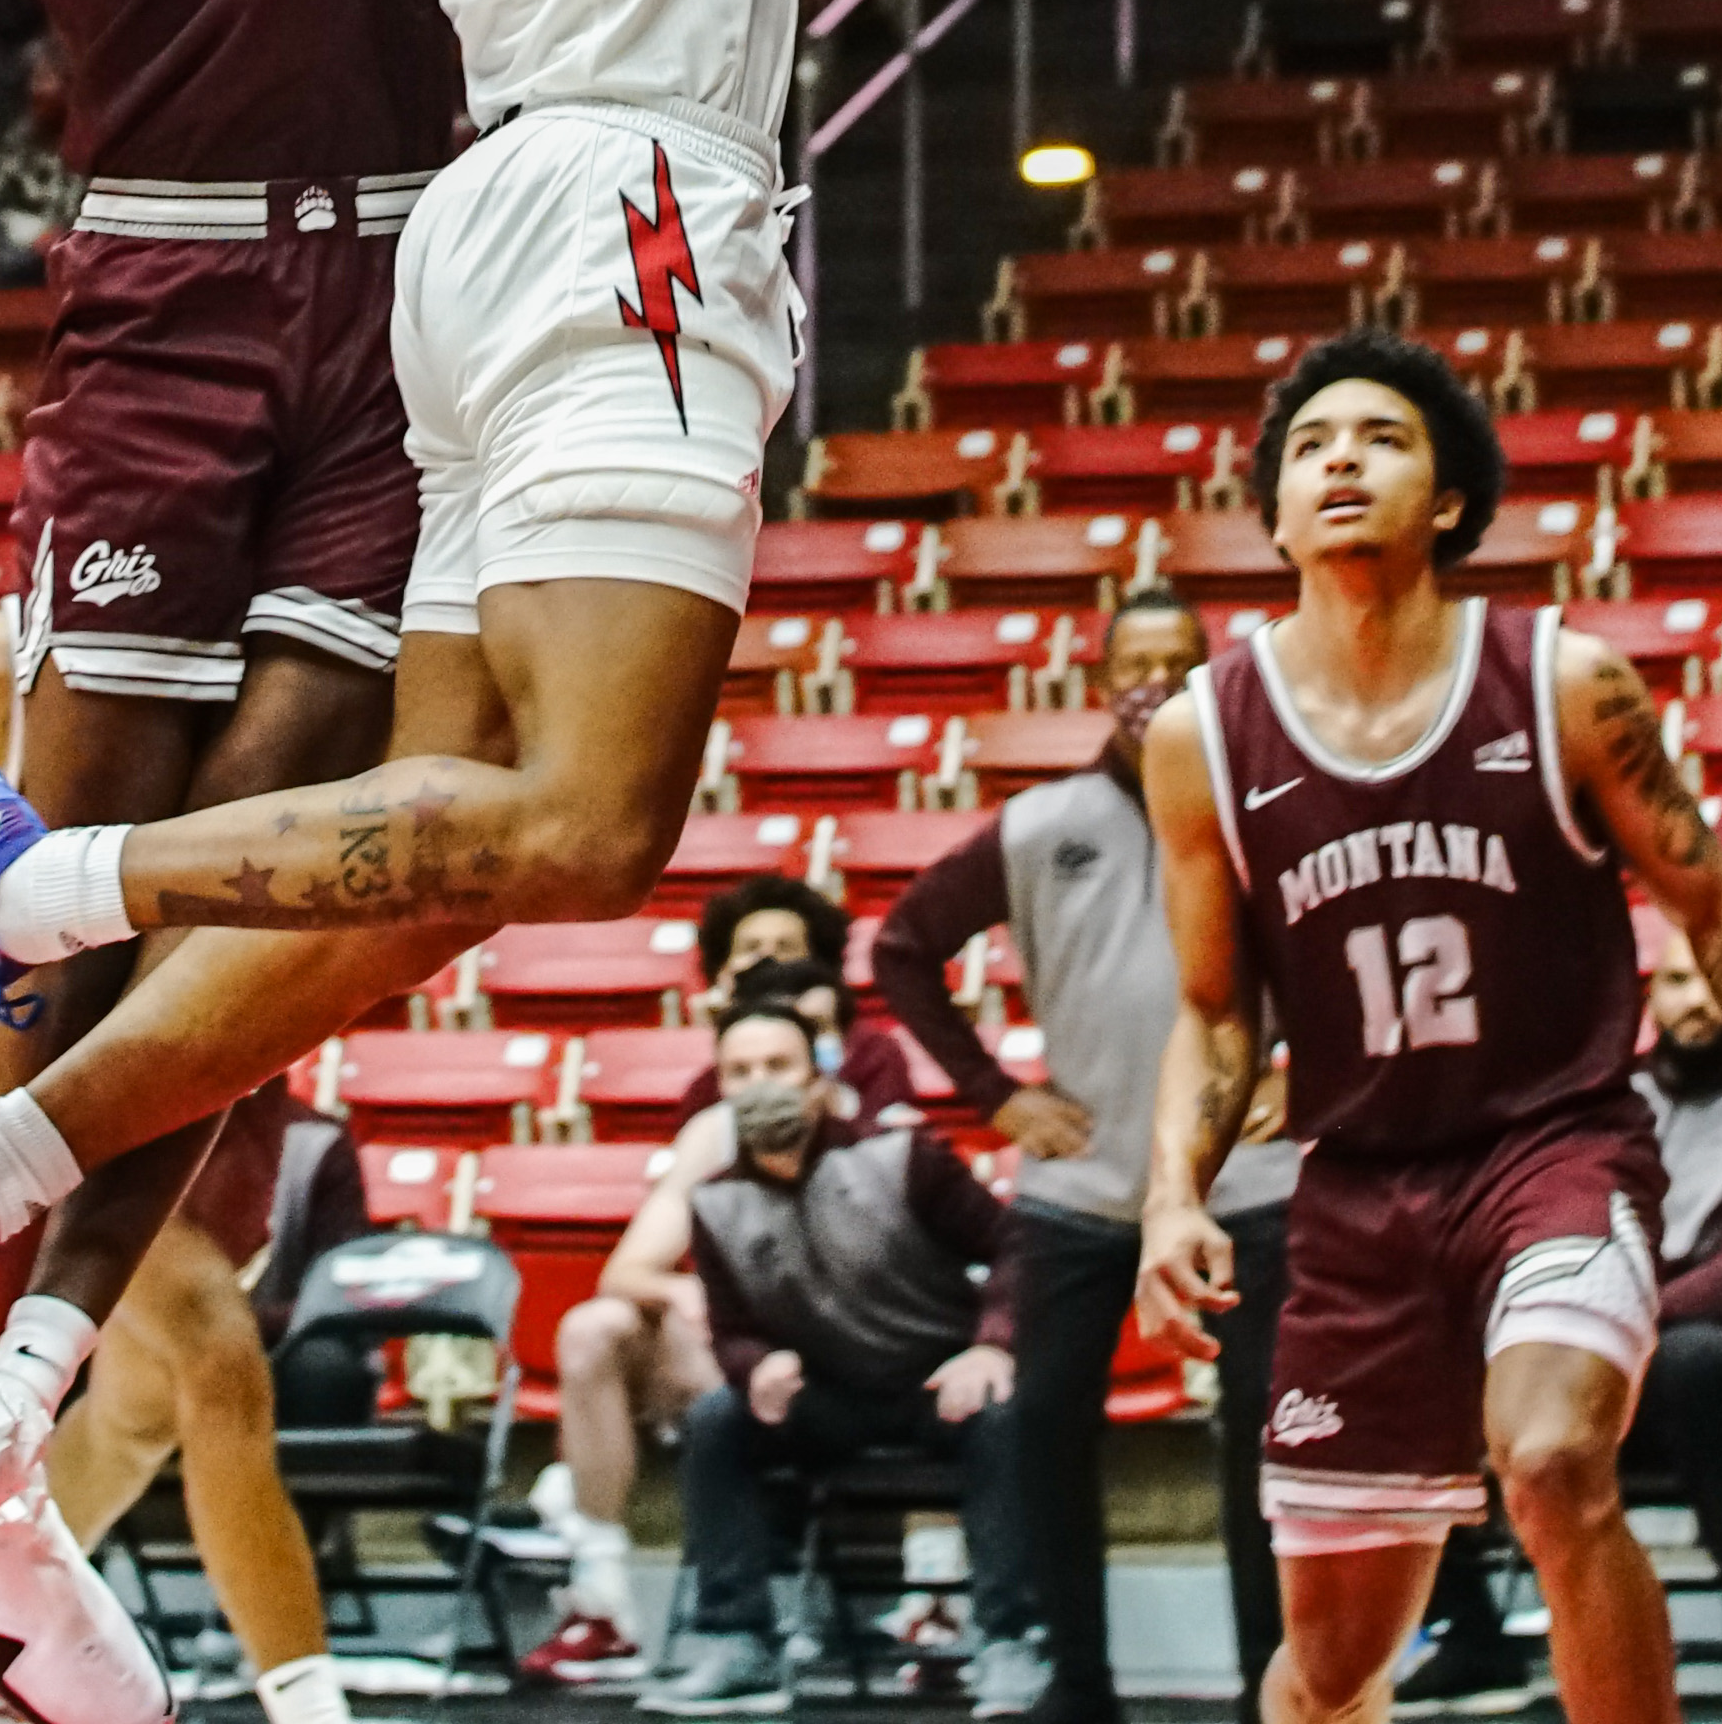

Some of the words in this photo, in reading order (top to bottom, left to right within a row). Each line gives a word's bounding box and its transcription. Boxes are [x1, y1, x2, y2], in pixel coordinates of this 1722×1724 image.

[69, 539, 162, 598] Griz
[1278, 821, 1517, 926] MONTANA
[1345, 914, 1480, 1058] 12
